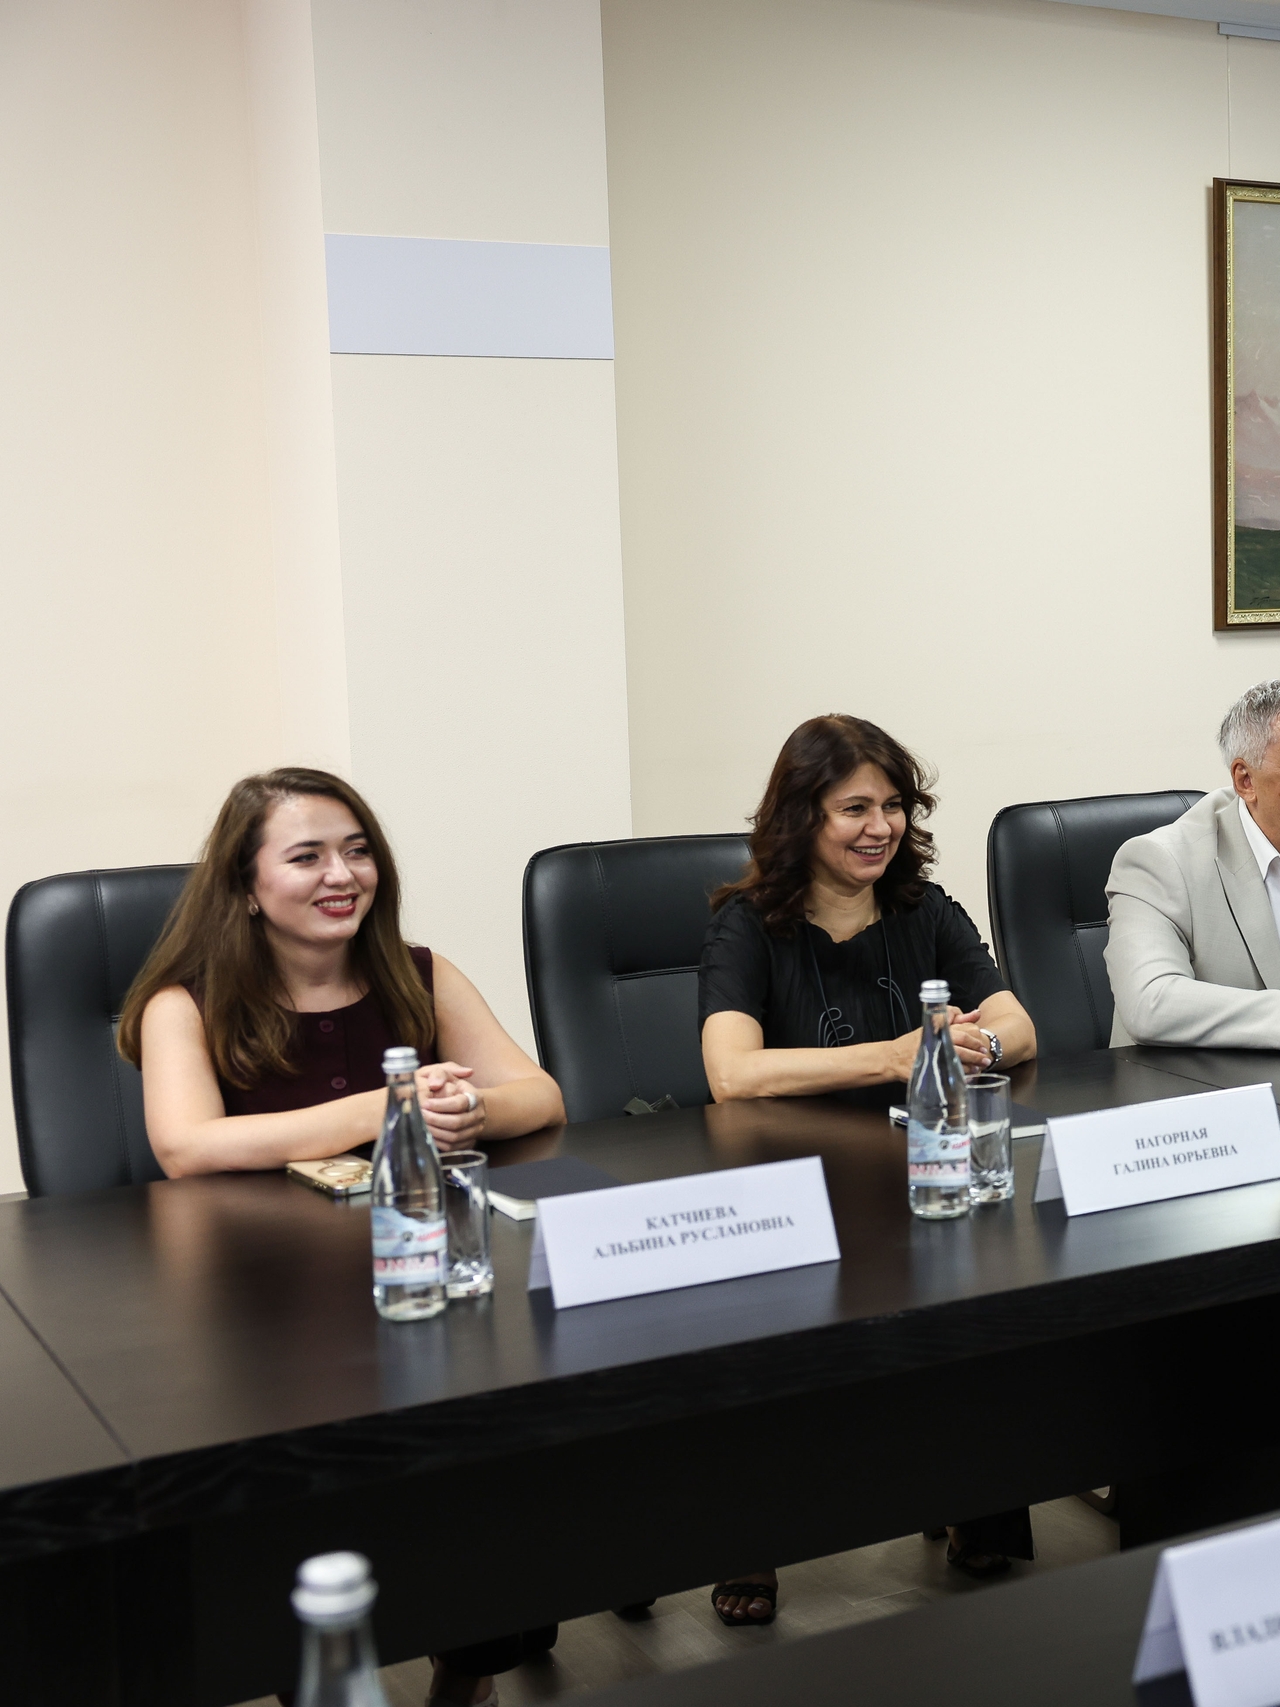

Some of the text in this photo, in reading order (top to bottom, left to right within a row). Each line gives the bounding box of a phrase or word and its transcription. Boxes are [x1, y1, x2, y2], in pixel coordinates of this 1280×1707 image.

[1135, 1128, 1209, 1150] НАГОРНАЯ
[1113, 1144, 1239, 1176] ГАЛИНА ЮРЬЕВНА
[646, 1205, 738, 1231] КАТЧИЕВА
[593, 1215, 795, 1260] АЛЬБИНА РУСЛАНОВНА
